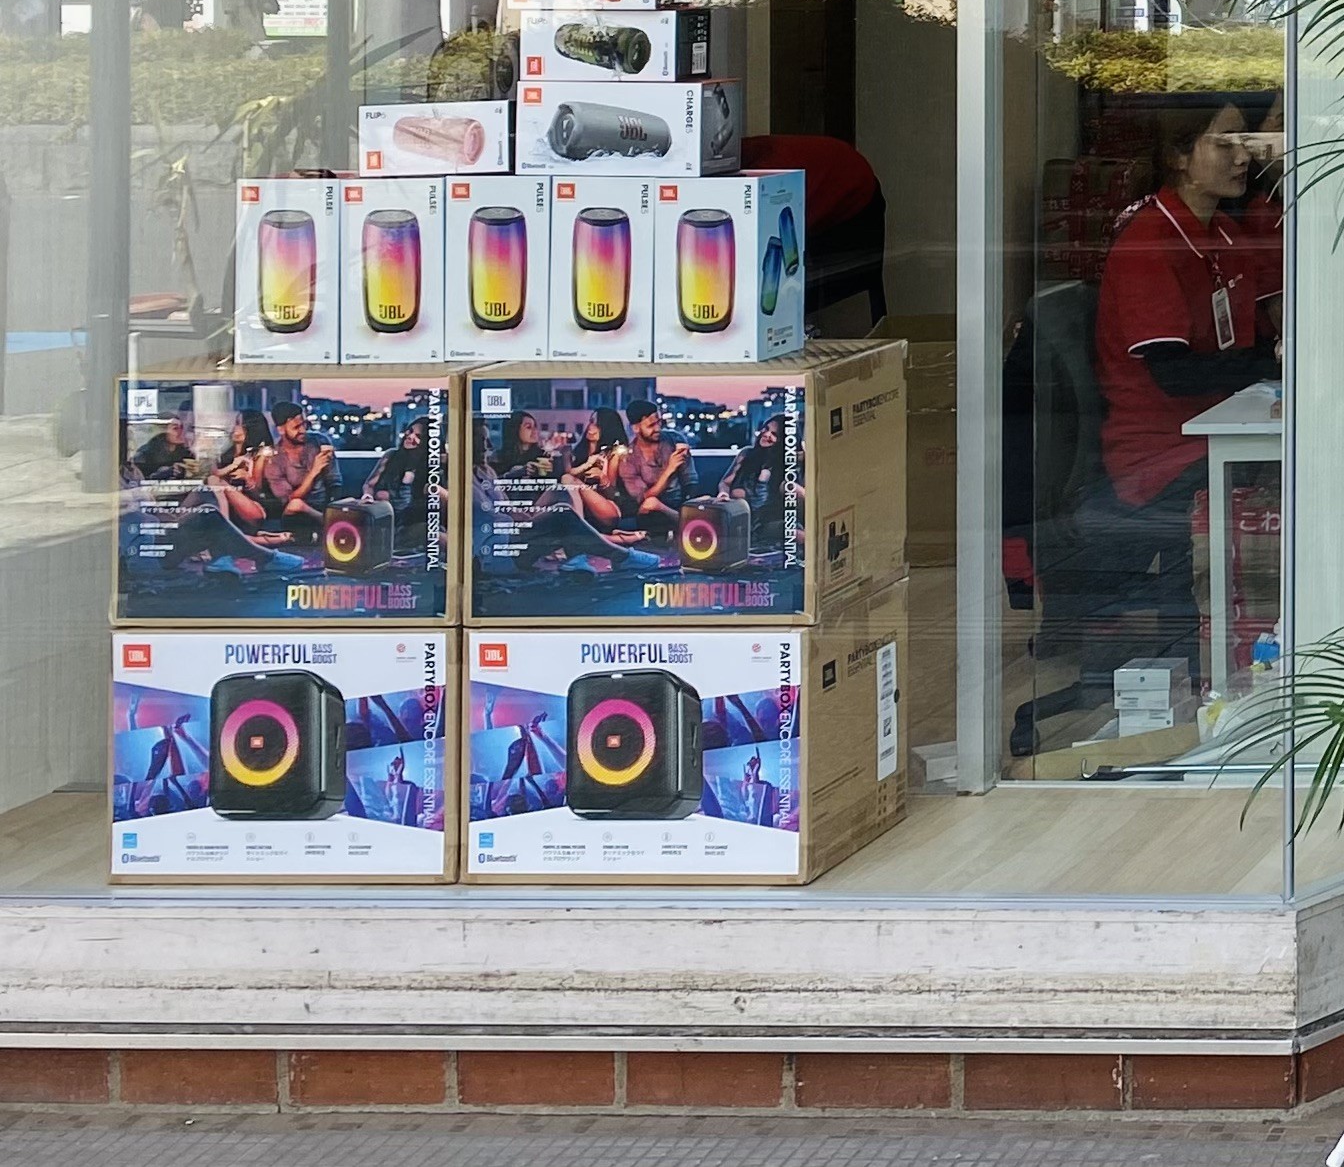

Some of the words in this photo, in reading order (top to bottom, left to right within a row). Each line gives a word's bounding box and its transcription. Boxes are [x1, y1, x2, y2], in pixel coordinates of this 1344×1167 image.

[685, 90, 694, 134] CHARGE5
[380, 304, 406, 320] JBL
[484, 301, 511, 317] JBL
[587, 301, 614, 318] JBL
[692, 303, 720, 320] JBL
[486, 394, 506, 408] JBL
[427, 511, 440, 572] ESSENTIAL
[783, 510, 797, 570] ESSENTIAL
[286, 584, 386, 610] POWERFUL
[643, 582, 743, 609] POWERFUL
[127, 649, 148, 663] JBL
[225, 644, 310, 664] POWERFUL
[311, 643, 333, 653] BASS
[311, 653, 337, 665] BOOST
[482, 649, 504, 663] JBL
[580, 643, 667, 664] POWERFUL
[668, 643, 689, 653] BASS
[668, 653, 693, 664] BOOST
[424, 766, 436, 827] ESSENTIAL
[779, 766, 791, 827] ESSENTIAL
